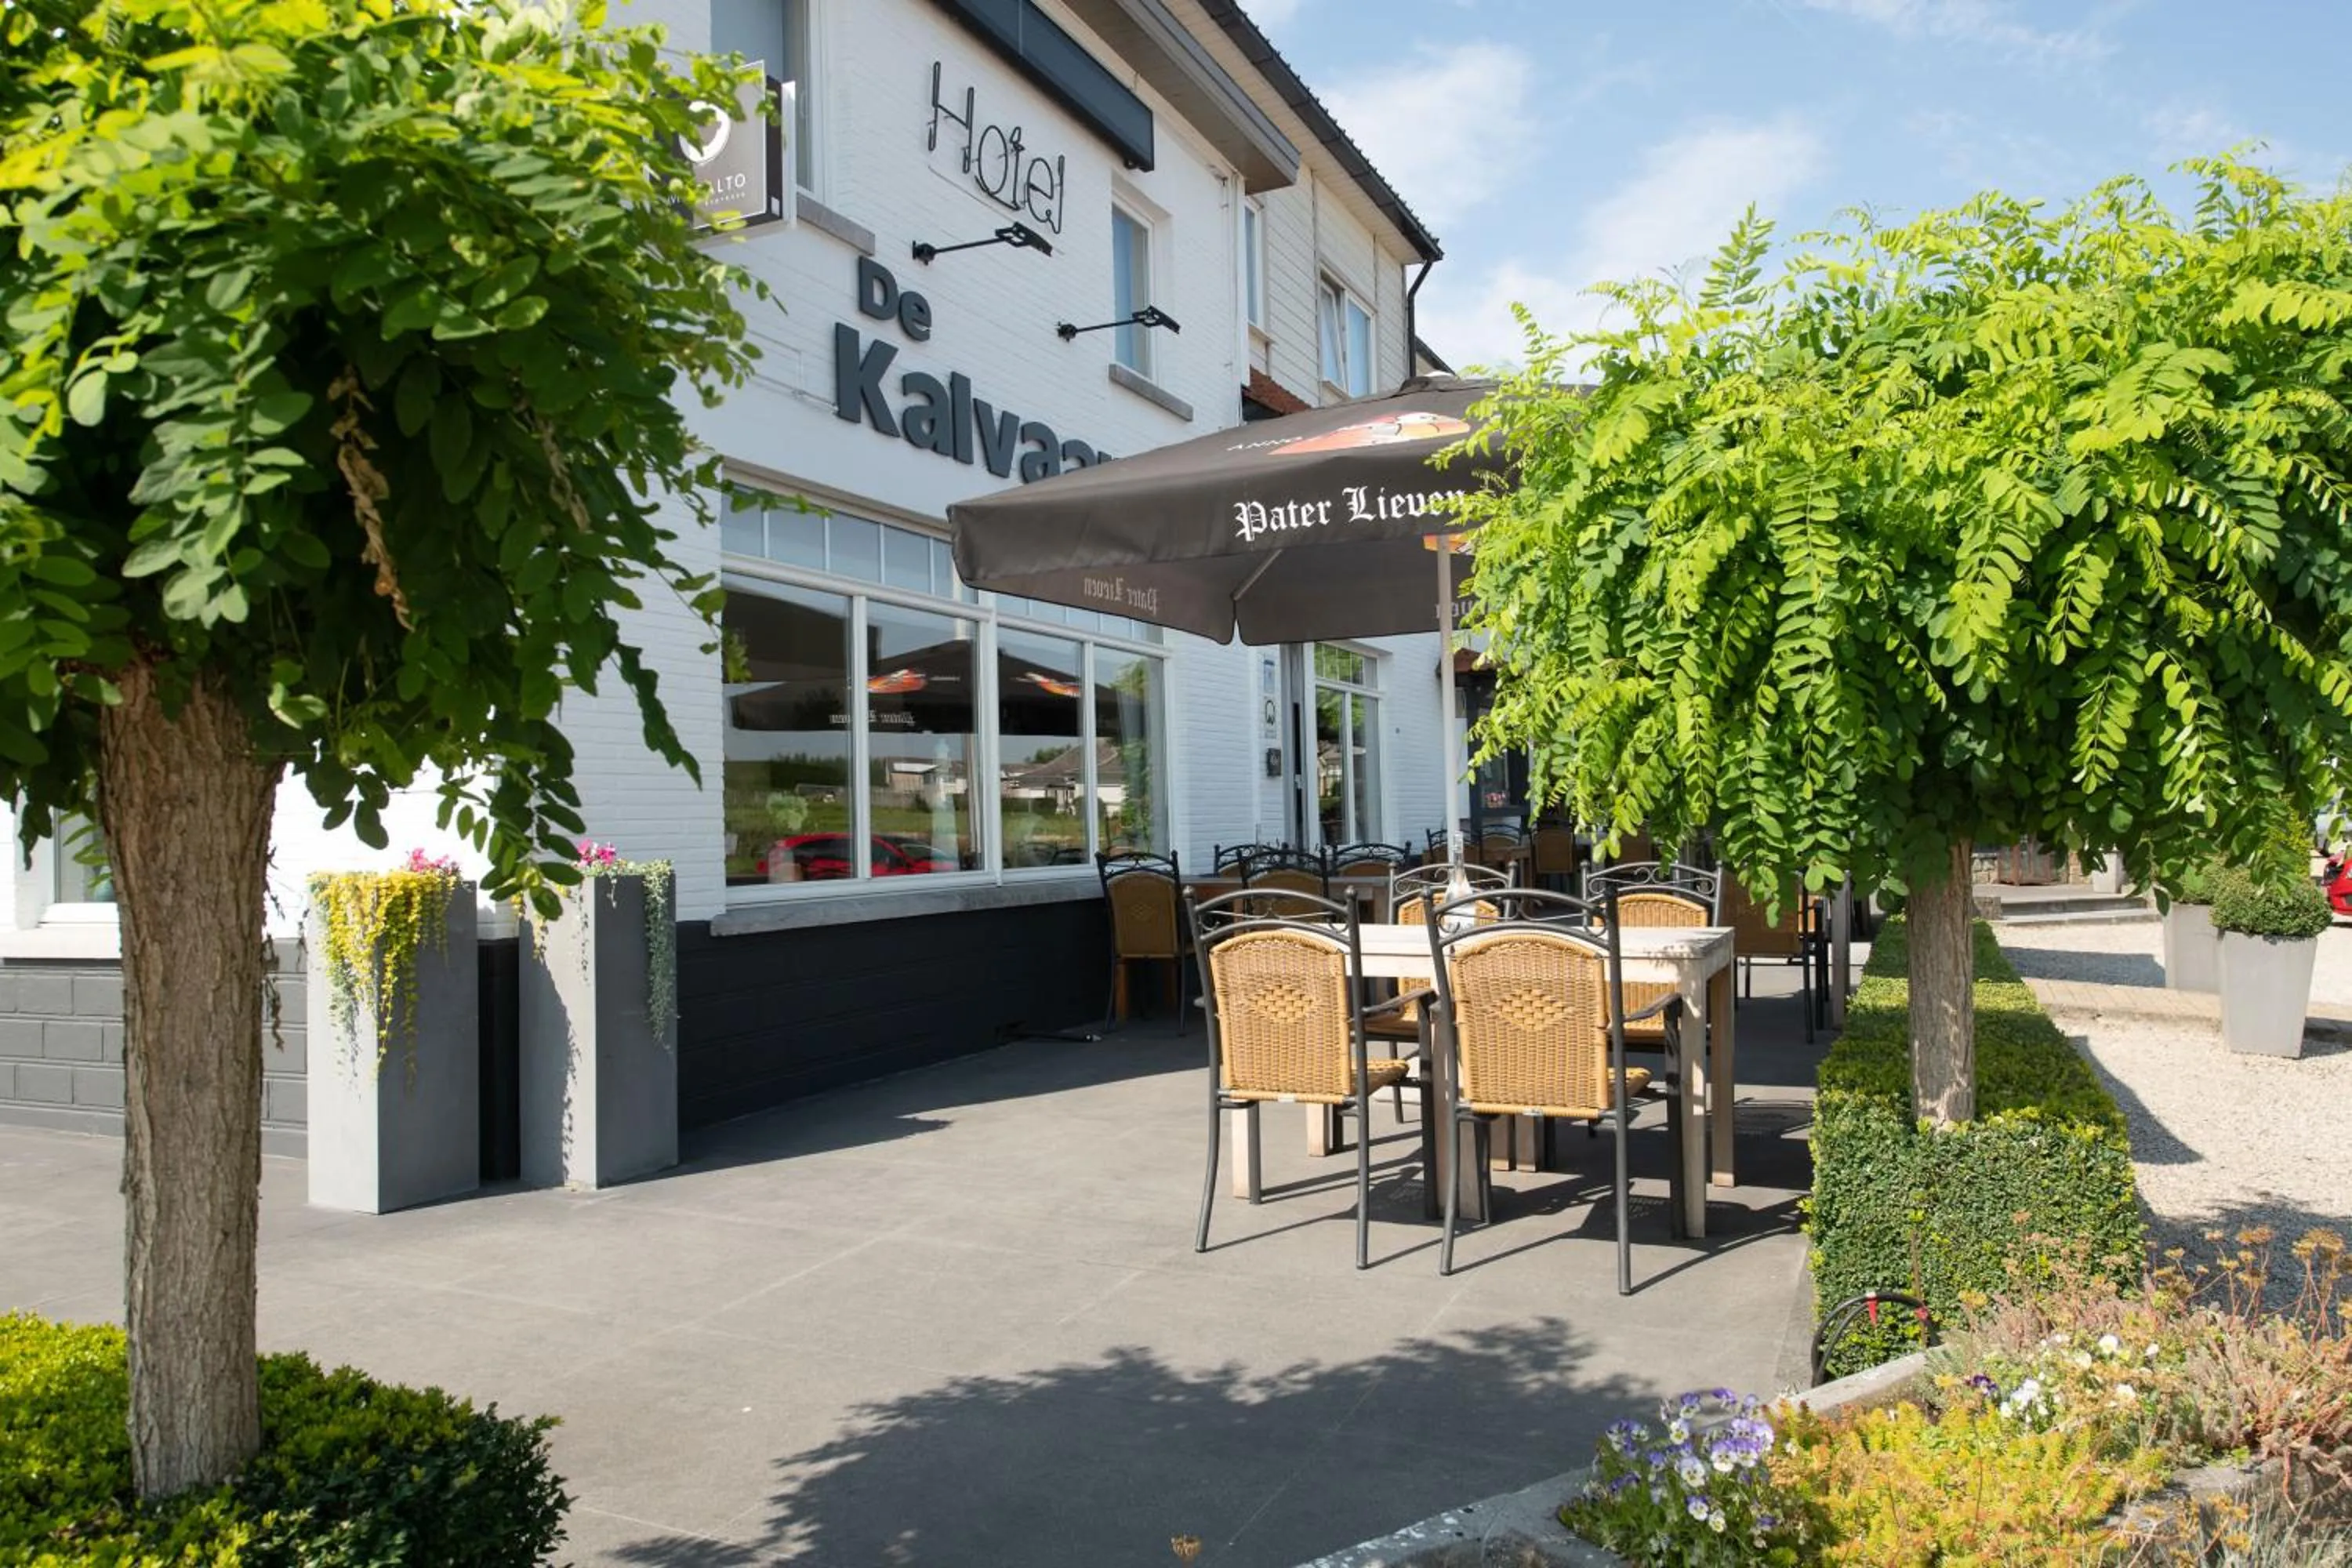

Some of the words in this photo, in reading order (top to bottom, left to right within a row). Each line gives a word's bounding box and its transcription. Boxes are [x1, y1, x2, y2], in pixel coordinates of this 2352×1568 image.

[928, 61, 1065, 234] Hotel
[858, 256, 931, 342] De
[835, 321, 1118, 484] Kalvaa
[1233, 499, 1332, 542] Pater
